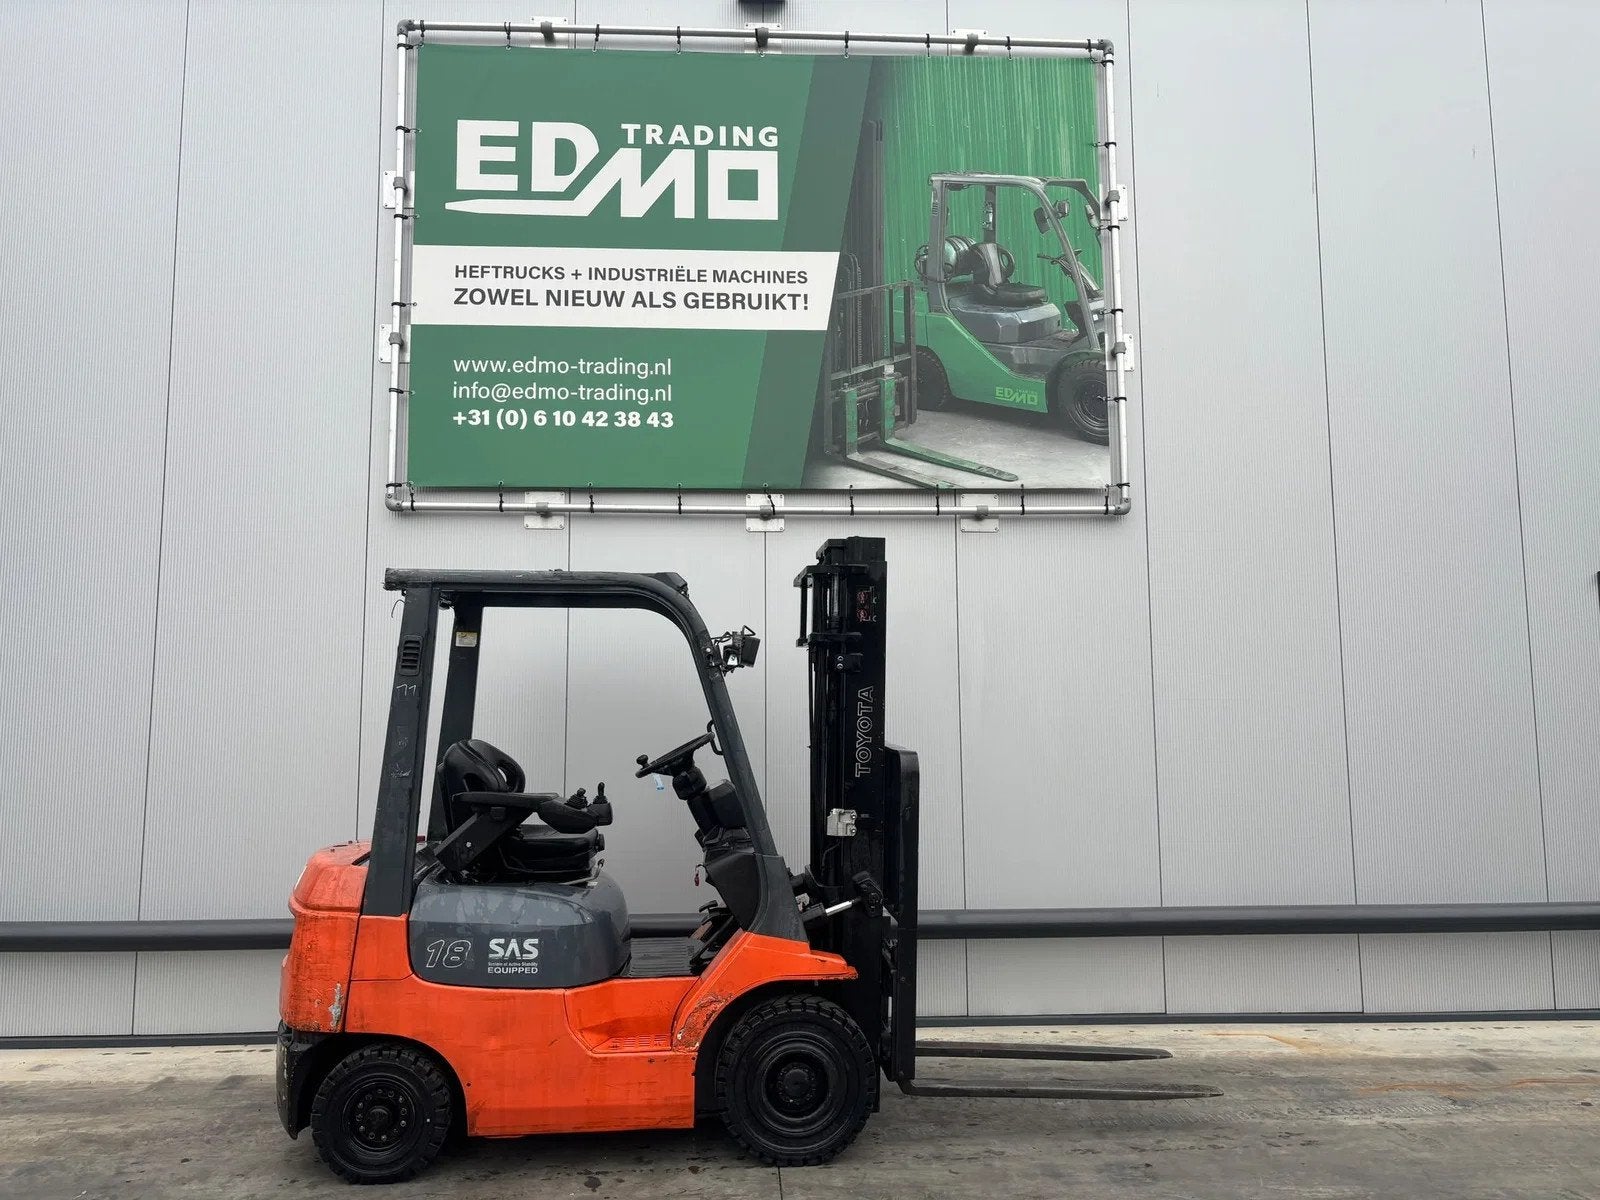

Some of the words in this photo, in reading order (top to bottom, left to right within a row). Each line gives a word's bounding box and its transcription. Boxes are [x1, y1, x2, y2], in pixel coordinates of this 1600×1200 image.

[621, 123, 778, 147] TRADING
[445, 119, 778, 220] EDMO
[455, 265, 565, 280] HEFTRUCKS
[588, 266, 707, 283] INDUSTRIËLE
[712, 269, 808, 284] MACHINES
[454, 288, 539, 306] ZOWEL
[545, 289, 625, 308] NIEUW
[631, 291, 677, 309] ALS
[683, 292, 809, 310] GEBRUIKT!
[453, 356, 672, 379] www.edmo-trading.nl
[453, 381, 672, 405] info@edmo-trading.nl
[994, 386, 1038, 405] EDMO
[453, 409, 490, 426] +31
[496, 408, 528, 430] (0)
[533, 410, 547, 426] 6
[553, 411, 576, 427] 10
[581, 411, 608, 427] 42
[614, 411, 641, 428] 38
[646, 412, 674, 428] 43
[855, 685, 874, 778] TOYOTA
[426, 939, 472, 969] 18
[488, 938, 539, 960] SAS
[487, 966, 539, 974] EQUIPPED
